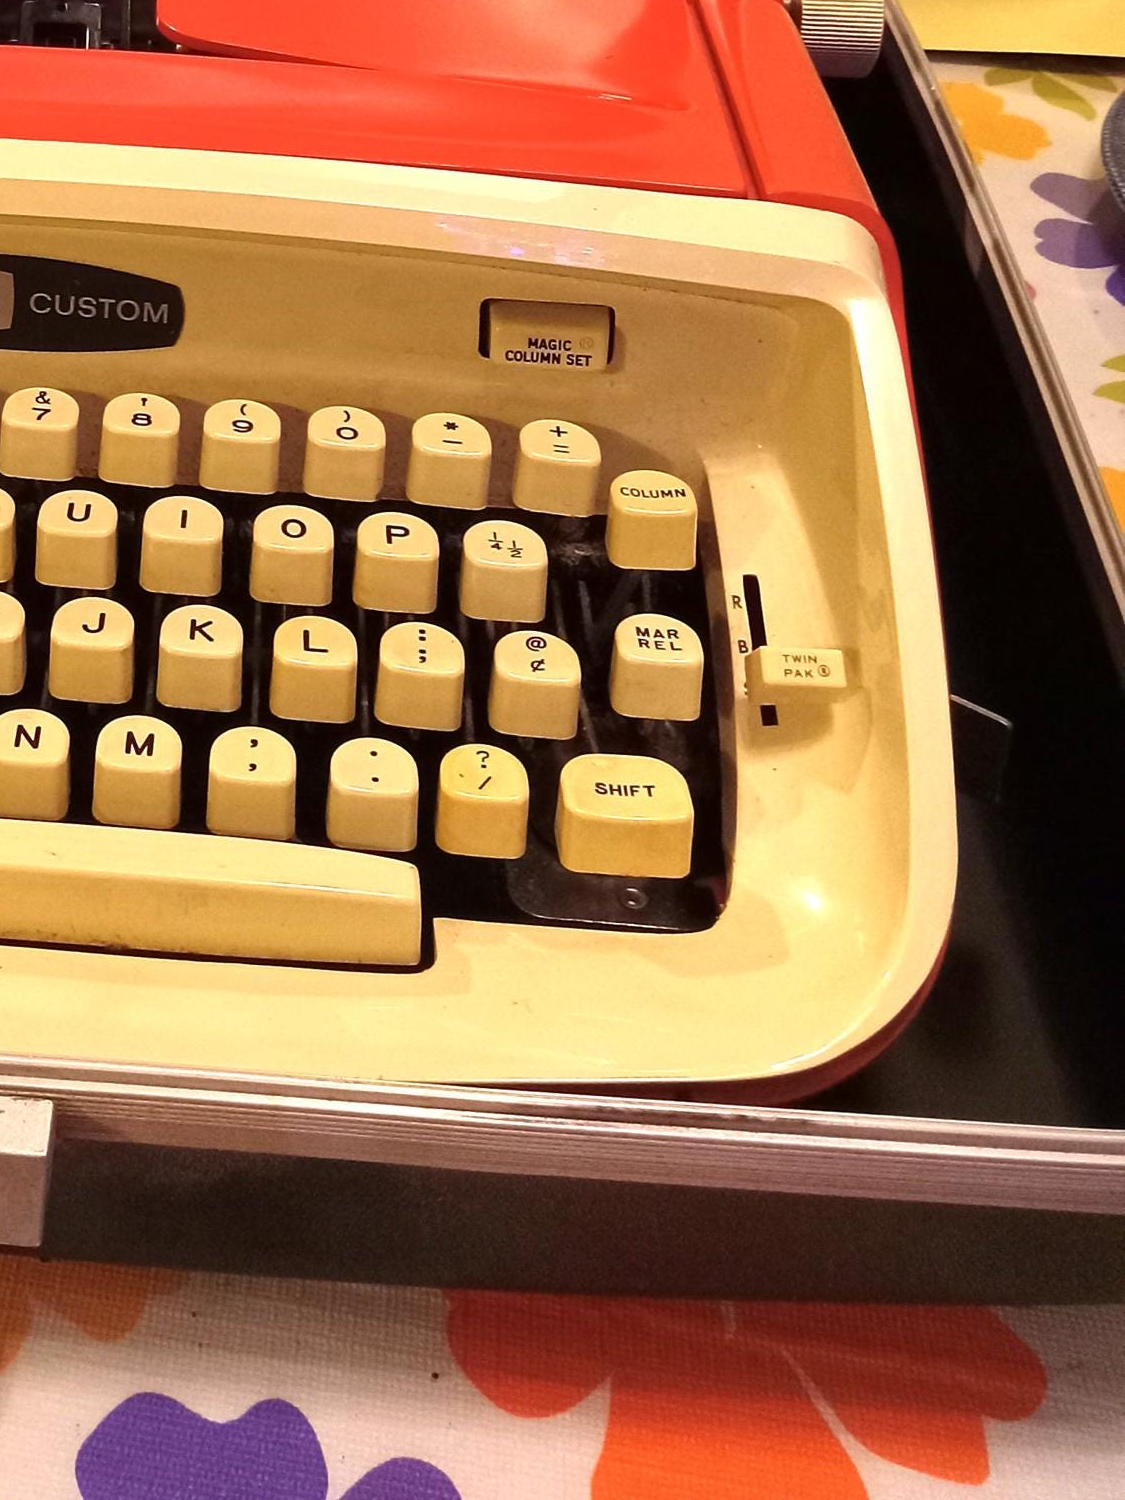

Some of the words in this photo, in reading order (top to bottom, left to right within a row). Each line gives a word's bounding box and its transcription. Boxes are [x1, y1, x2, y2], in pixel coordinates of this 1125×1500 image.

[29, 292, 169, 324] CUSTOM
[528, 337, 572, 351] MAGIC
[505, 350, 561, 365] COLUMN
[566, 354, 592, 367] SET
[35, 390, 51, 405] &
[31, 407, 52, 421] 7
[131, 412, 153, 427] 8
[231, 419, 254, 434] 9
[549, 425, 569, 438] +
[552, 444, 570, 454] =
[619, 486, 687, 499] COLUMN
[66, 502, 92, 523] U
[180, 509, 188, 529] I
[280, 518, 307, 539] O
[385, 524, 410, 545] P
[732, 595, 742, 609] R
[81, 612, 107, 634] J
[189, 618, 215, 643] K
[635, 626, 680, 641] MAR
[302, 629, 329, 654] L
[525, 636, 548, 652] @
[637, 638, 683, 651] REL
[738, 640, 749, 653] B
[783, 655, 817, 663] TWIN
[784, 669, 813, 677] PAK
[13, 724, 42, 750] N
[124, 730, 155, 757] M
[475, 750, 490, 769] ?
[594, 782, 656, 798] SHIFT
